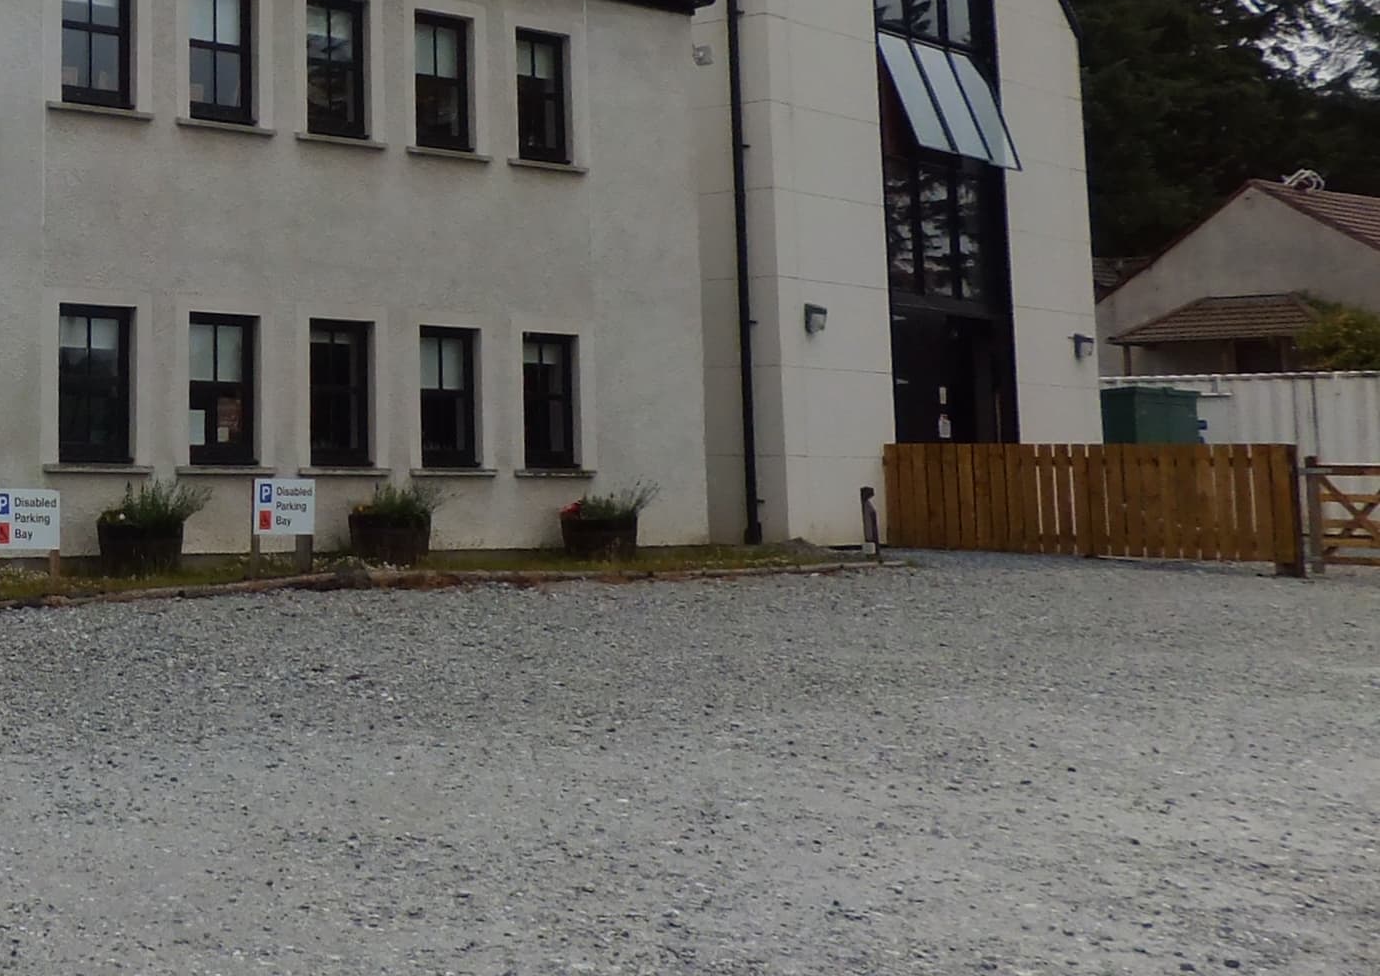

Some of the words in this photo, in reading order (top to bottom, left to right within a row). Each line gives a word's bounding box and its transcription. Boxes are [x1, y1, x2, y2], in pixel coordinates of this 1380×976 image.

[262, 486, 271, 501] P
[276, 486, 313, 496] Disabled
[14, 497, 57, 508] Disabled
[276, 501, 307, 512] Parking
[14, 512, 51, 526] Parking
[275, 515, 292, 527] Bay
[14, 528, 34, 541] Bay
